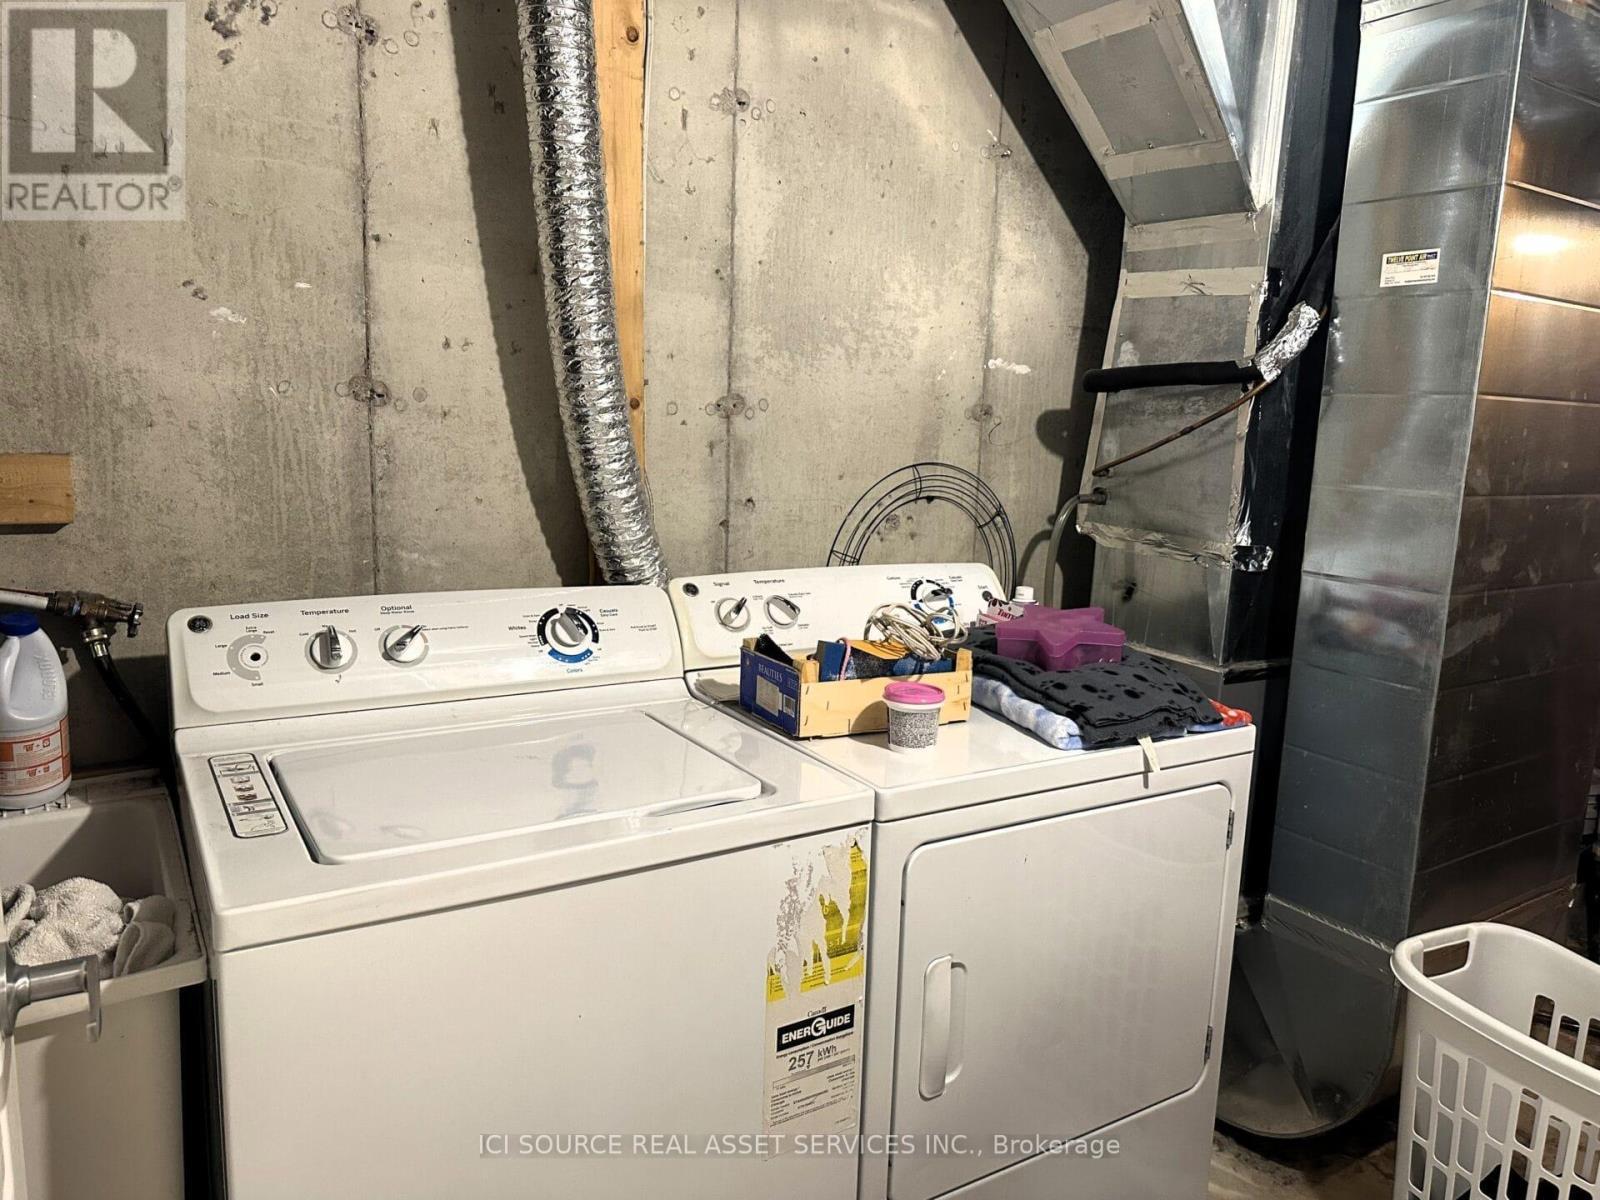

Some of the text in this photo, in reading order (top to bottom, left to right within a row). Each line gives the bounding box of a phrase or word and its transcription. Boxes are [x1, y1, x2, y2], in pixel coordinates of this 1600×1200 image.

[300, 608, 350, 616] Temperature
[380, 604, 413, 612] Optional
[817, 1044, 838, 1058] kWh
[788, 1050, 815, 1071] 257
